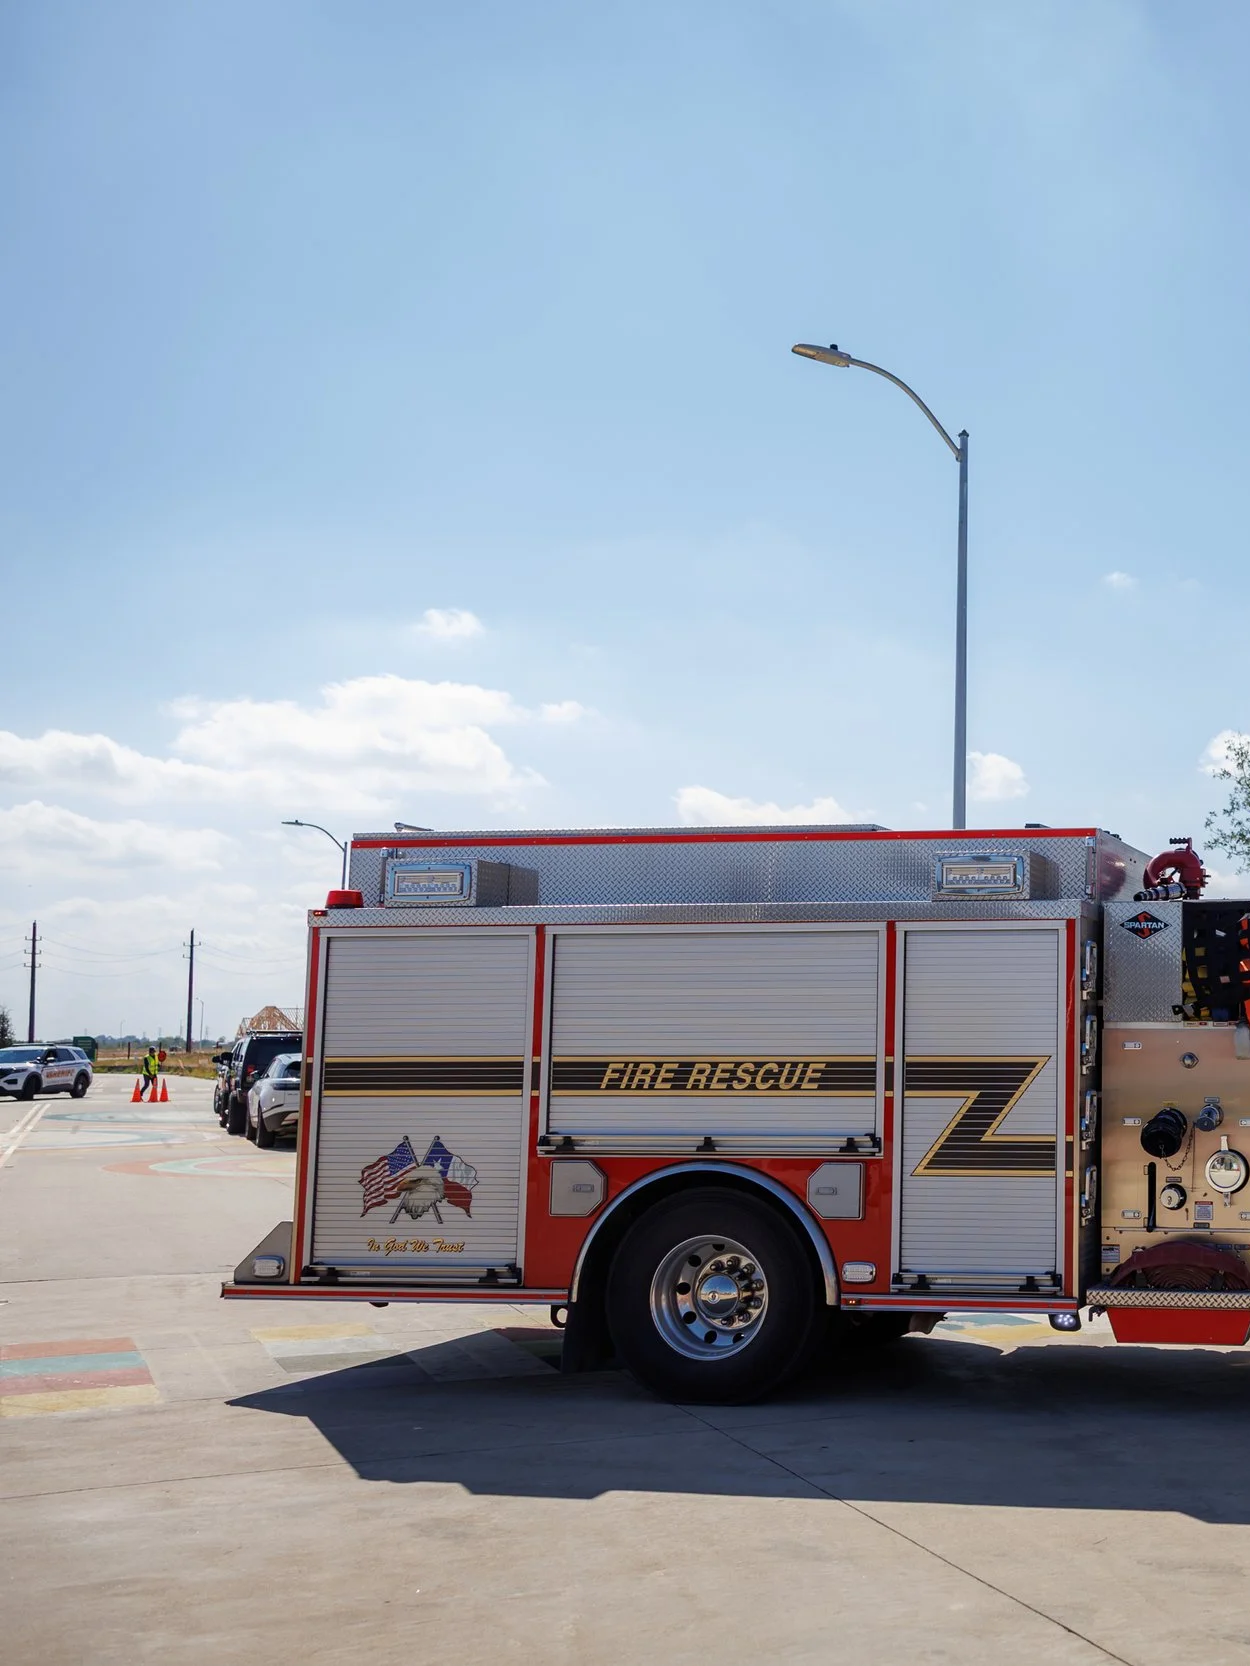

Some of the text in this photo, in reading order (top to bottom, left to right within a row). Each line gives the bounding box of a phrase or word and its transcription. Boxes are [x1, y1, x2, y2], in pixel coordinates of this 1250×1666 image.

[1123, 921, 1164, 929] SPARTAN
[600, 1062, 827, 1090] FIRE RESCUE
[367, 1237, 465, 1256] In God We Trust
